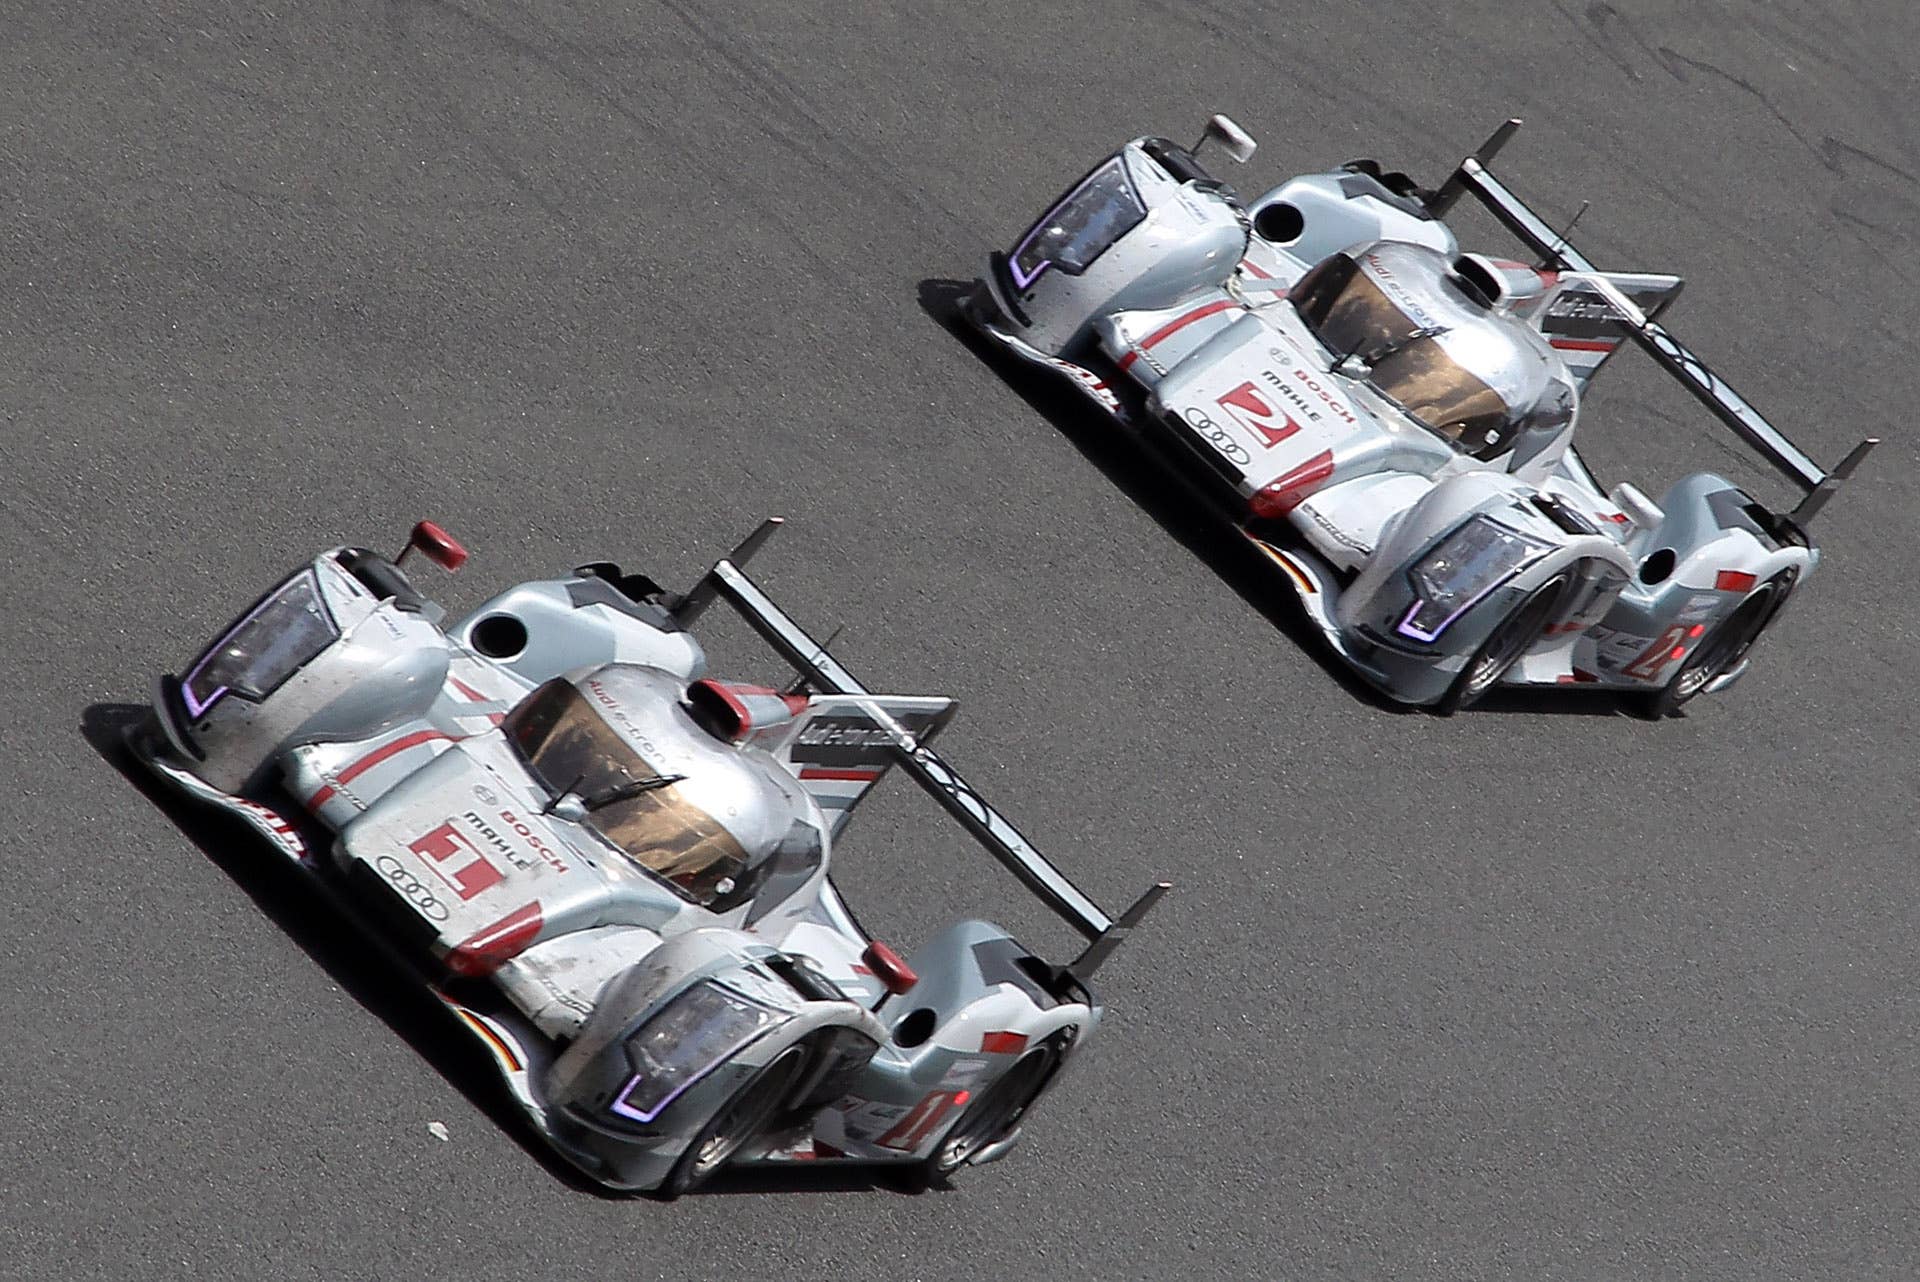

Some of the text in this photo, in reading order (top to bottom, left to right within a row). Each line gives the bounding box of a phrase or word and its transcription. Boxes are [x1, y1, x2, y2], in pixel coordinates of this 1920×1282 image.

[1366, 254, 1393, 279] Audi
[1222, 388, 1289, 444] 2
[1261, 370, 1322, 422] MAHLE
[1294, 370, 1357, 423] BOSCH
[1630, 627, 1685, 677] 2
[589, 681, 620, 709] Audi
[418, 833, 480, 892] 1
[463, 811, 532, 872] MAHLE
[500, 810, 570, 873] BOSCH
[885, 1093, 946, 1147] 1
